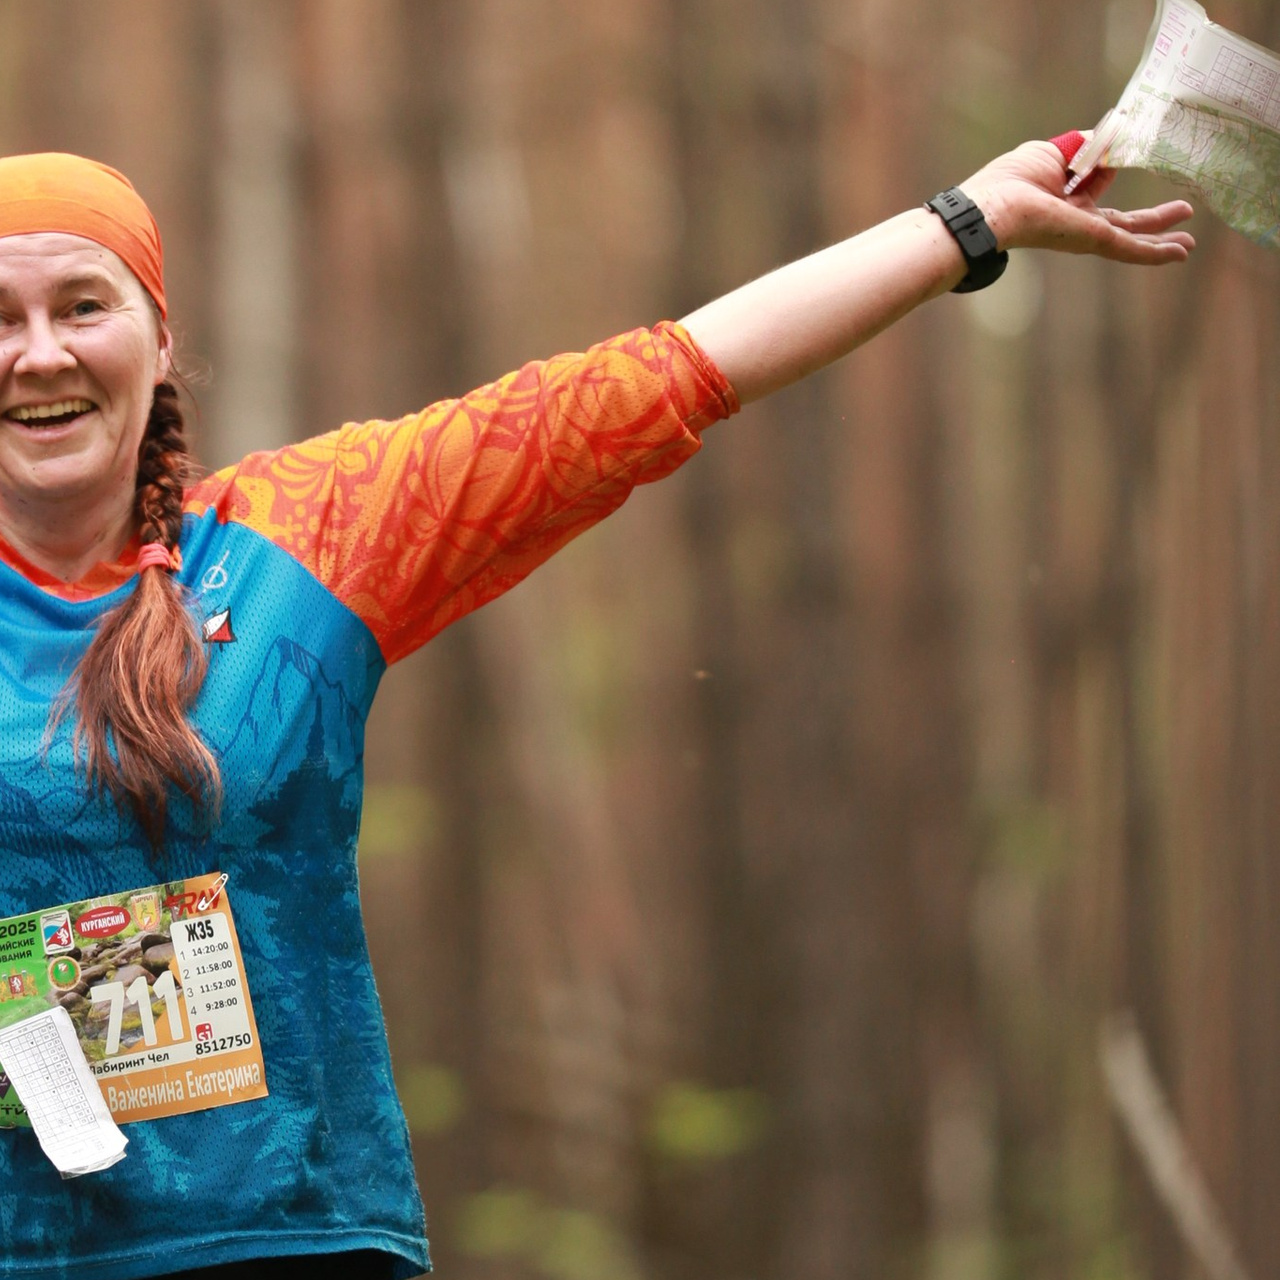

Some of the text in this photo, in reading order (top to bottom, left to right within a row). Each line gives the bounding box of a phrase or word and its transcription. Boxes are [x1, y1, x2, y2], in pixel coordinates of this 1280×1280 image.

[80, 911, 126, 932] КУРГАНСКИЙ
[185, 919, 215, 942] Ж35
[180, 941, 229, 960] 1 14:20:00
[183, 959, 233, 980] 2 11:58:00
[186, 978, 237, 998] 3 11:52:00
[91, 970, 185, 1055] 711
[190, 996, 238, 1016] 4 9:28:00
[195, 1032, 252, 1056] 8512750
[147, 1052, 170, 1063] Чел
[107, 1062, 261, 1113] Важенина Екатерина
